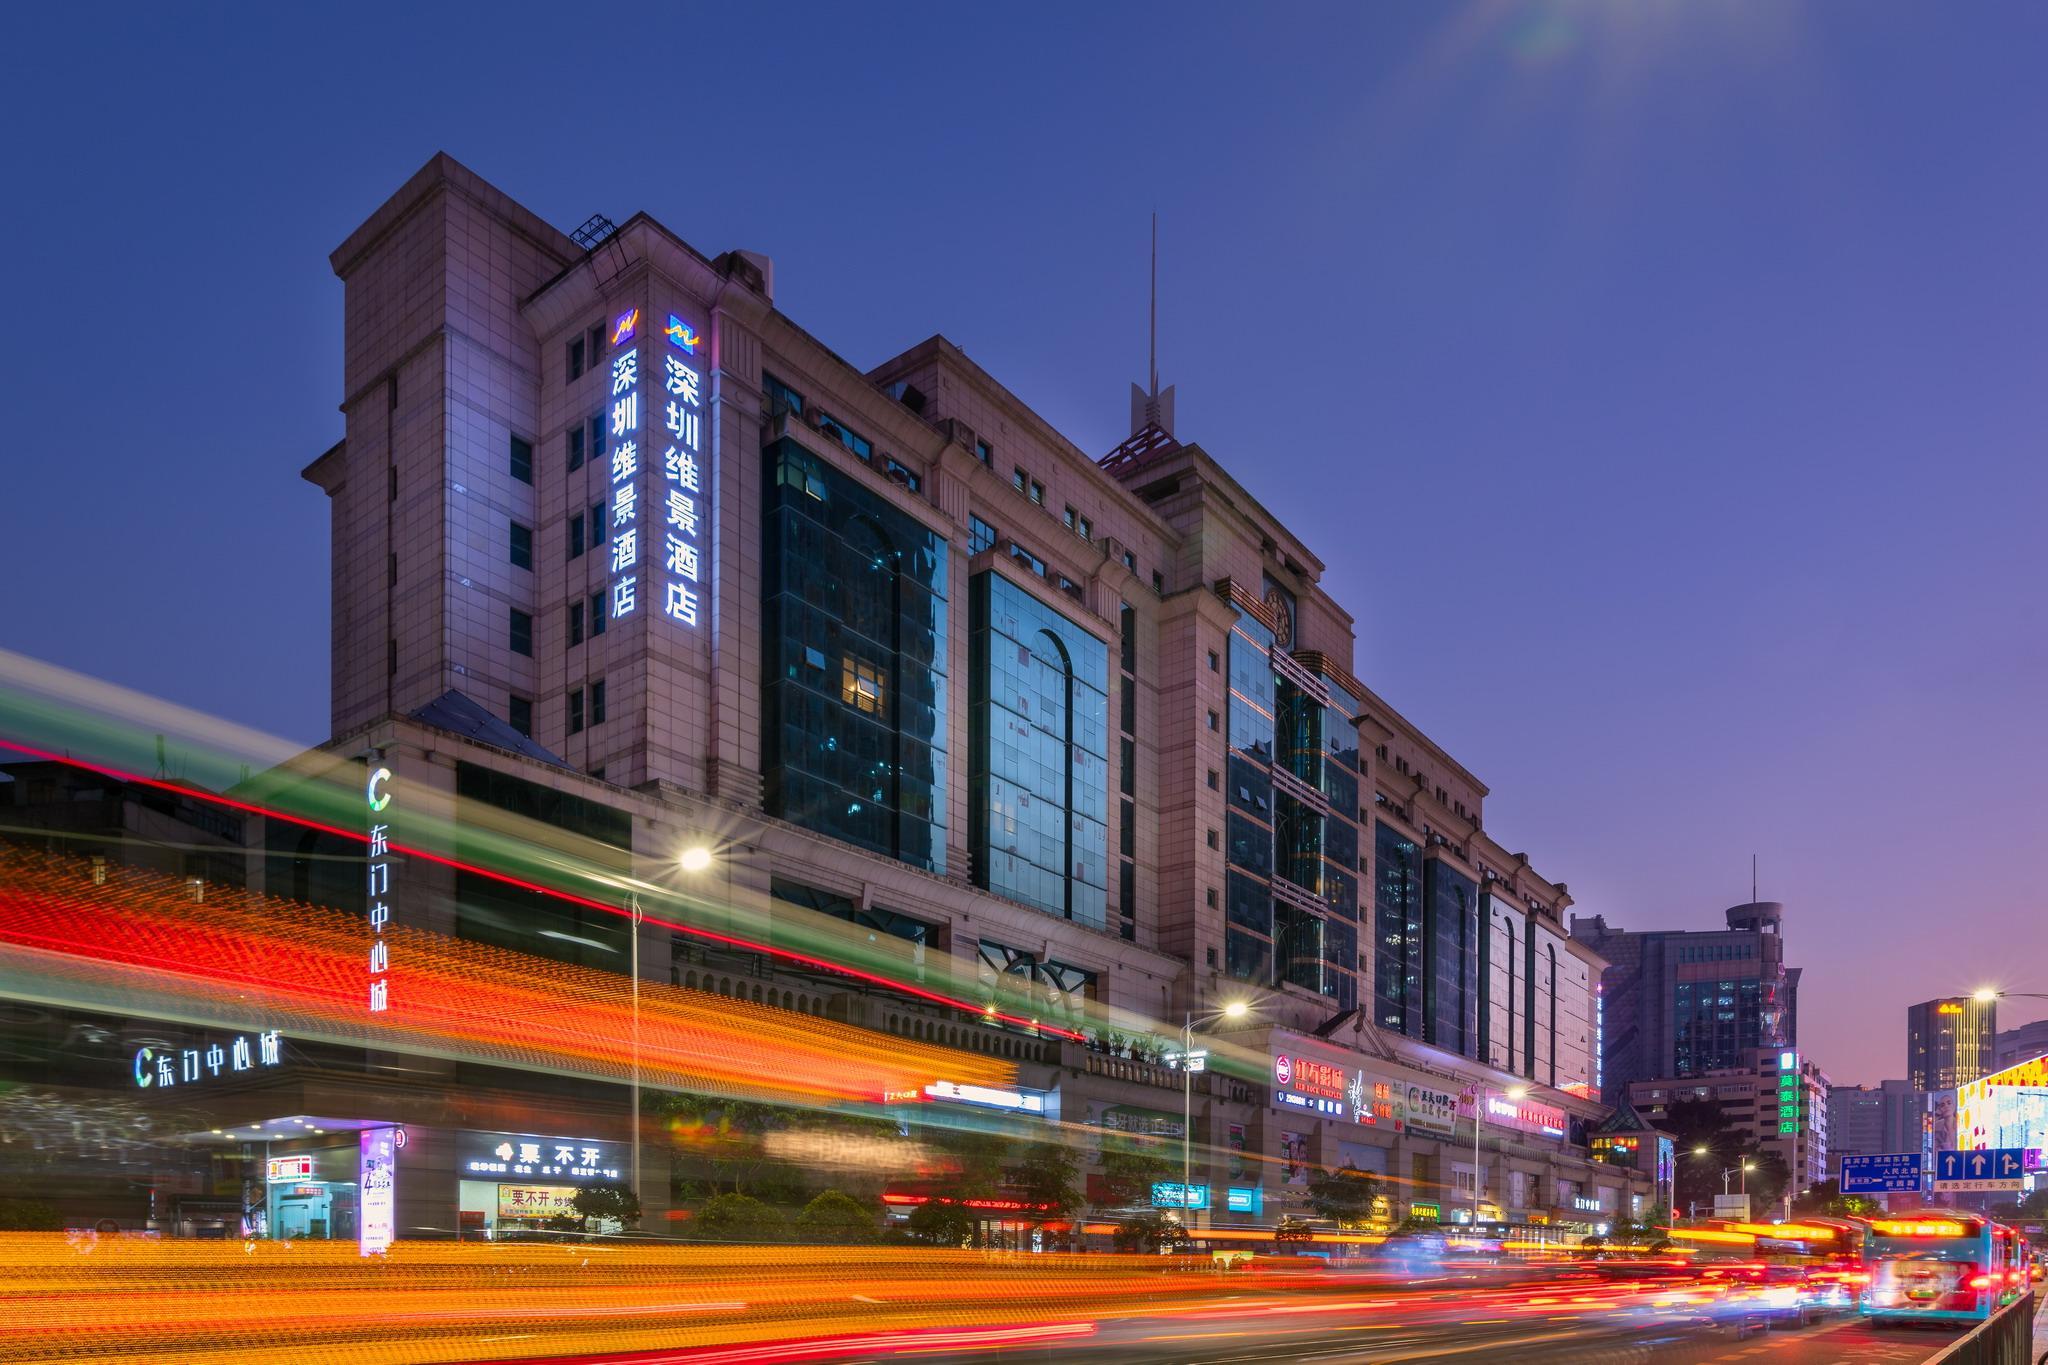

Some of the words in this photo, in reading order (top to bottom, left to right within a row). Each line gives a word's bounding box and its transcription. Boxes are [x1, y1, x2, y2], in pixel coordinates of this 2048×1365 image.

[612, 348, 638, 619] 深圳维景酒店
[665, 354, 700, 627] 深圳维景酒店
[370, 824, 389, 1012] 东门中心城
[156, 1029, 283, 1087] 东门中心城
[512, 1189, 550, 1207] 栗不开
